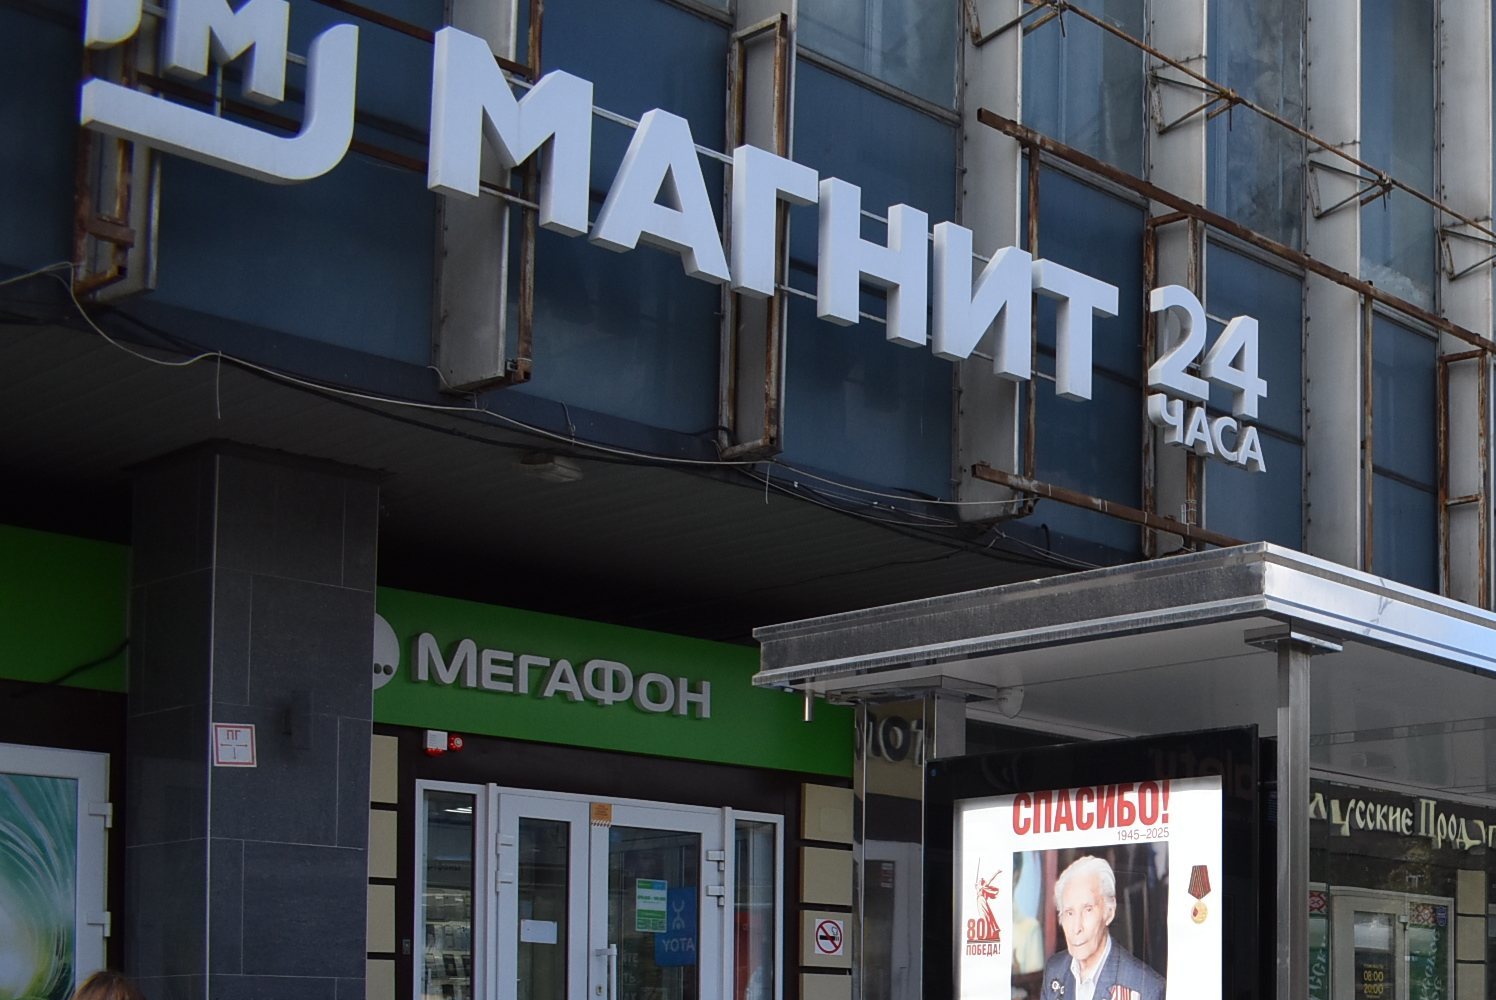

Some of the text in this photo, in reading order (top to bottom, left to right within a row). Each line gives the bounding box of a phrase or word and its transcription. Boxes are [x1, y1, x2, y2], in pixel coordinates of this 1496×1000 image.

[427, 26, 1119, 401] МАГНИТ
[1148, 284, 1267, 419] 24
[1148, 394, 1266, 473] ЧАСА
[226, 729, 241, 741] ПГ
[1012, 779, 1171, 836] СПАСИБО!
[662, 937, 697, 953] YOTA
[966, 918, 987, 941] 80
[966, 942, 1001, 956] ПОБЕДА!
